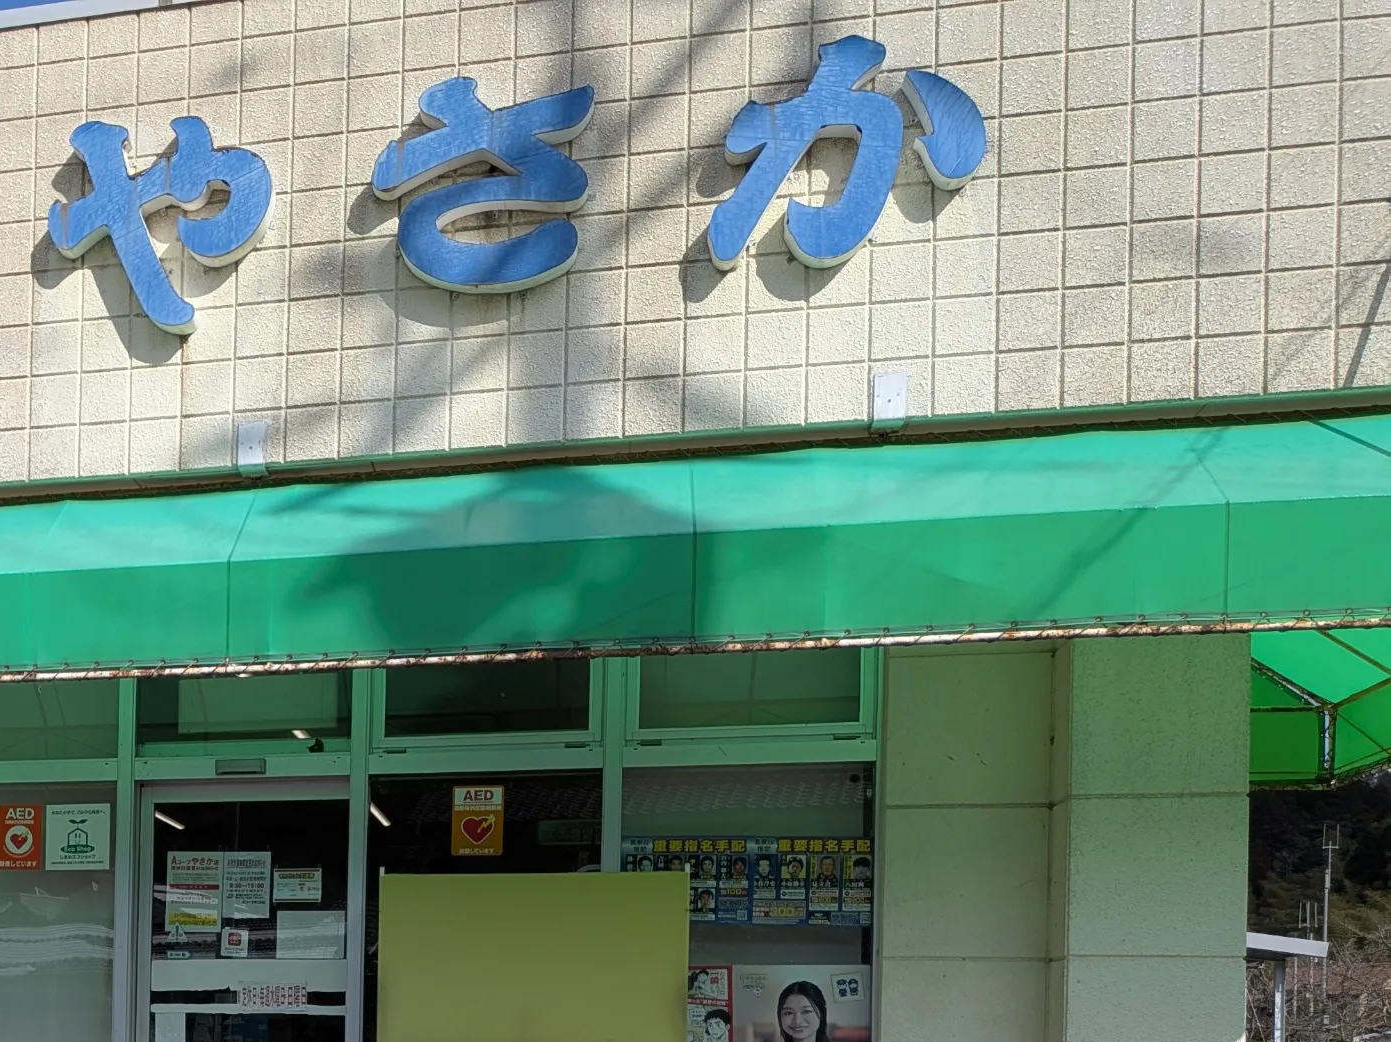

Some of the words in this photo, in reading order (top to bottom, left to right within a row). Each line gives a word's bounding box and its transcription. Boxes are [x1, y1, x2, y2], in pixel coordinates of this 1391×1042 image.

[47, 33, 988, 336] やさか
[463, 790, 494, 801] AED
[5, 808, 35, 820] AED
[653, 839, 746, 853] 重要指名手配
[778, 839, 871, 852] 重要指名手配
